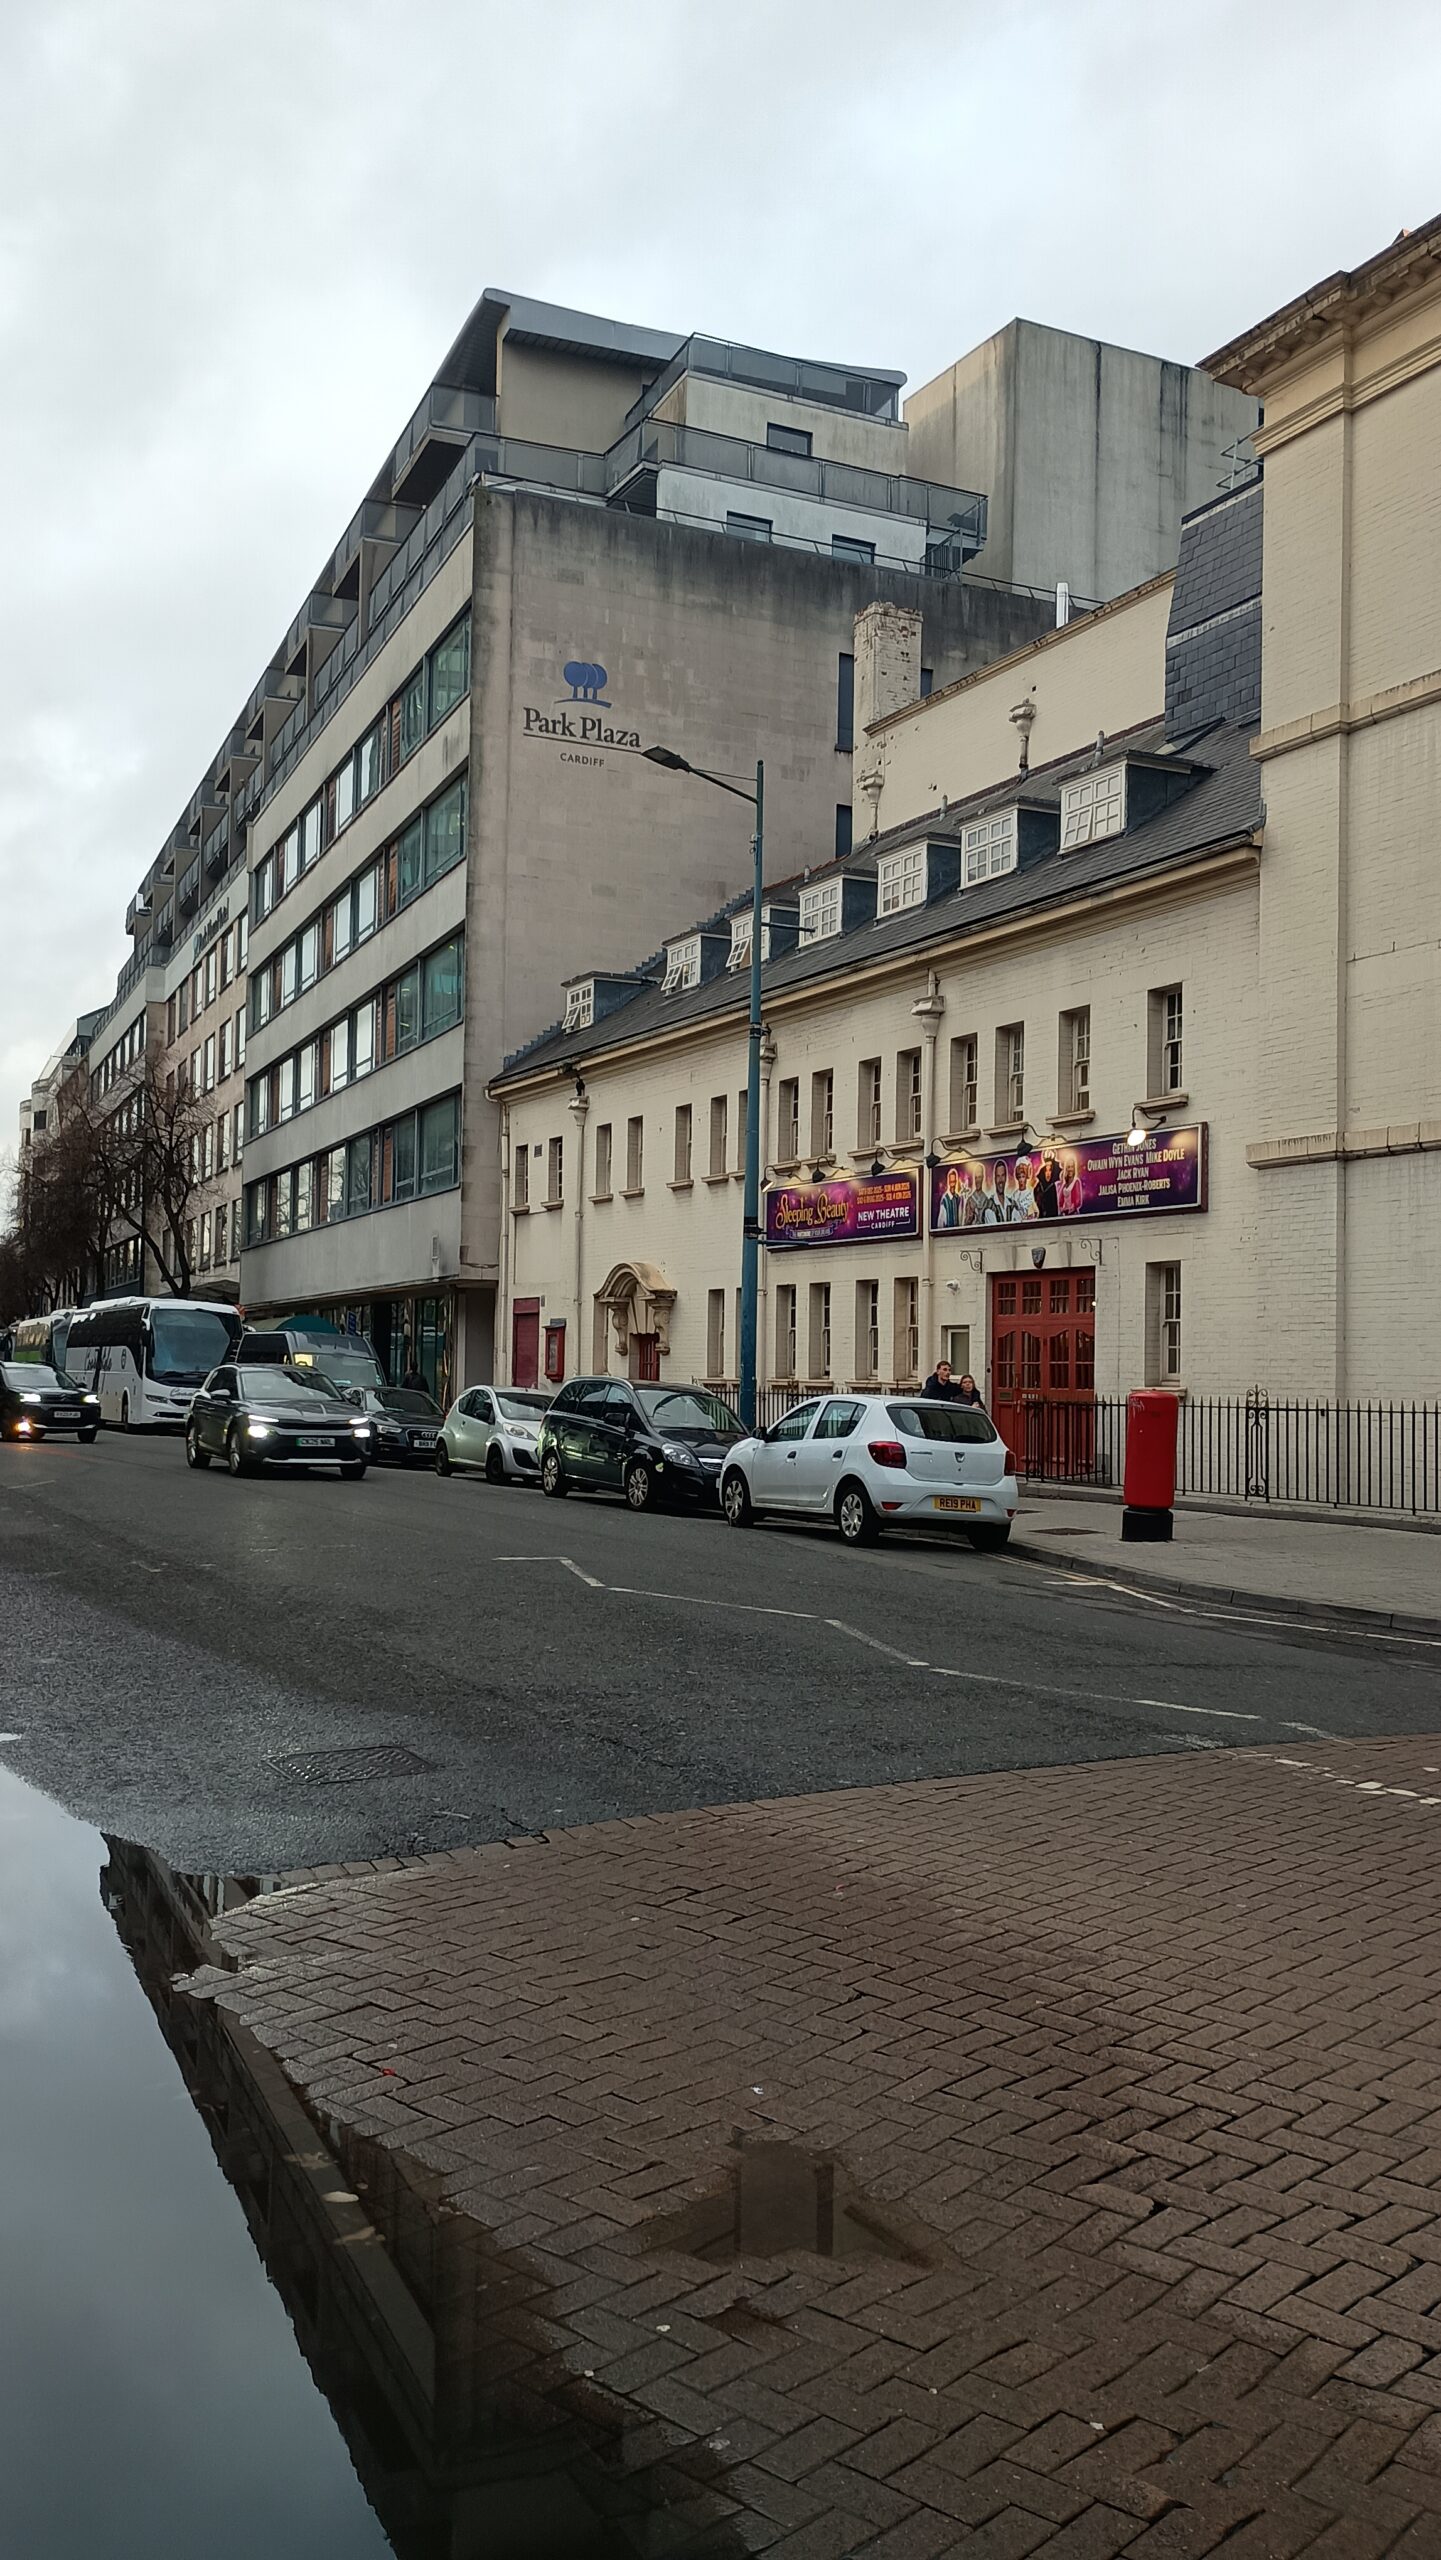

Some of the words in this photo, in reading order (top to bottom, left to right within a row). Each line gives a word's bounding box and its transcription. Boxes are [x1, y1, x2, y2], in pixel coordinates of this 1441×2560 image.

[523, 707, 577, 738] Park
[580, 716, 641, 748] Plaza
[560, 753, 605, 767] CARDIFF
[1108, 1157, 1122, 1169] WYN
[1124, 1154, 1143, 1167] EVANS
[1146, 1151, 1162, 1164] MIKE
[1163, 1148, 1185, 1161] DOYLE
[1117, 1168, 1131, 1180] JACK
[1133, 1167, 1149, 1178] RYAN
[776, 1194, 813, 1229] Sleeping
[814, 1193, 848, 1224] Beauty
[858, 1210, 874, 1222] NEW
[876, 1207, 909, 1219] THEATRE
[871, 1221, 895, 1229] CARDIFF
[939, 1498, 959, 1509] RE19
[960, 1499, 976, 1510] PHA
